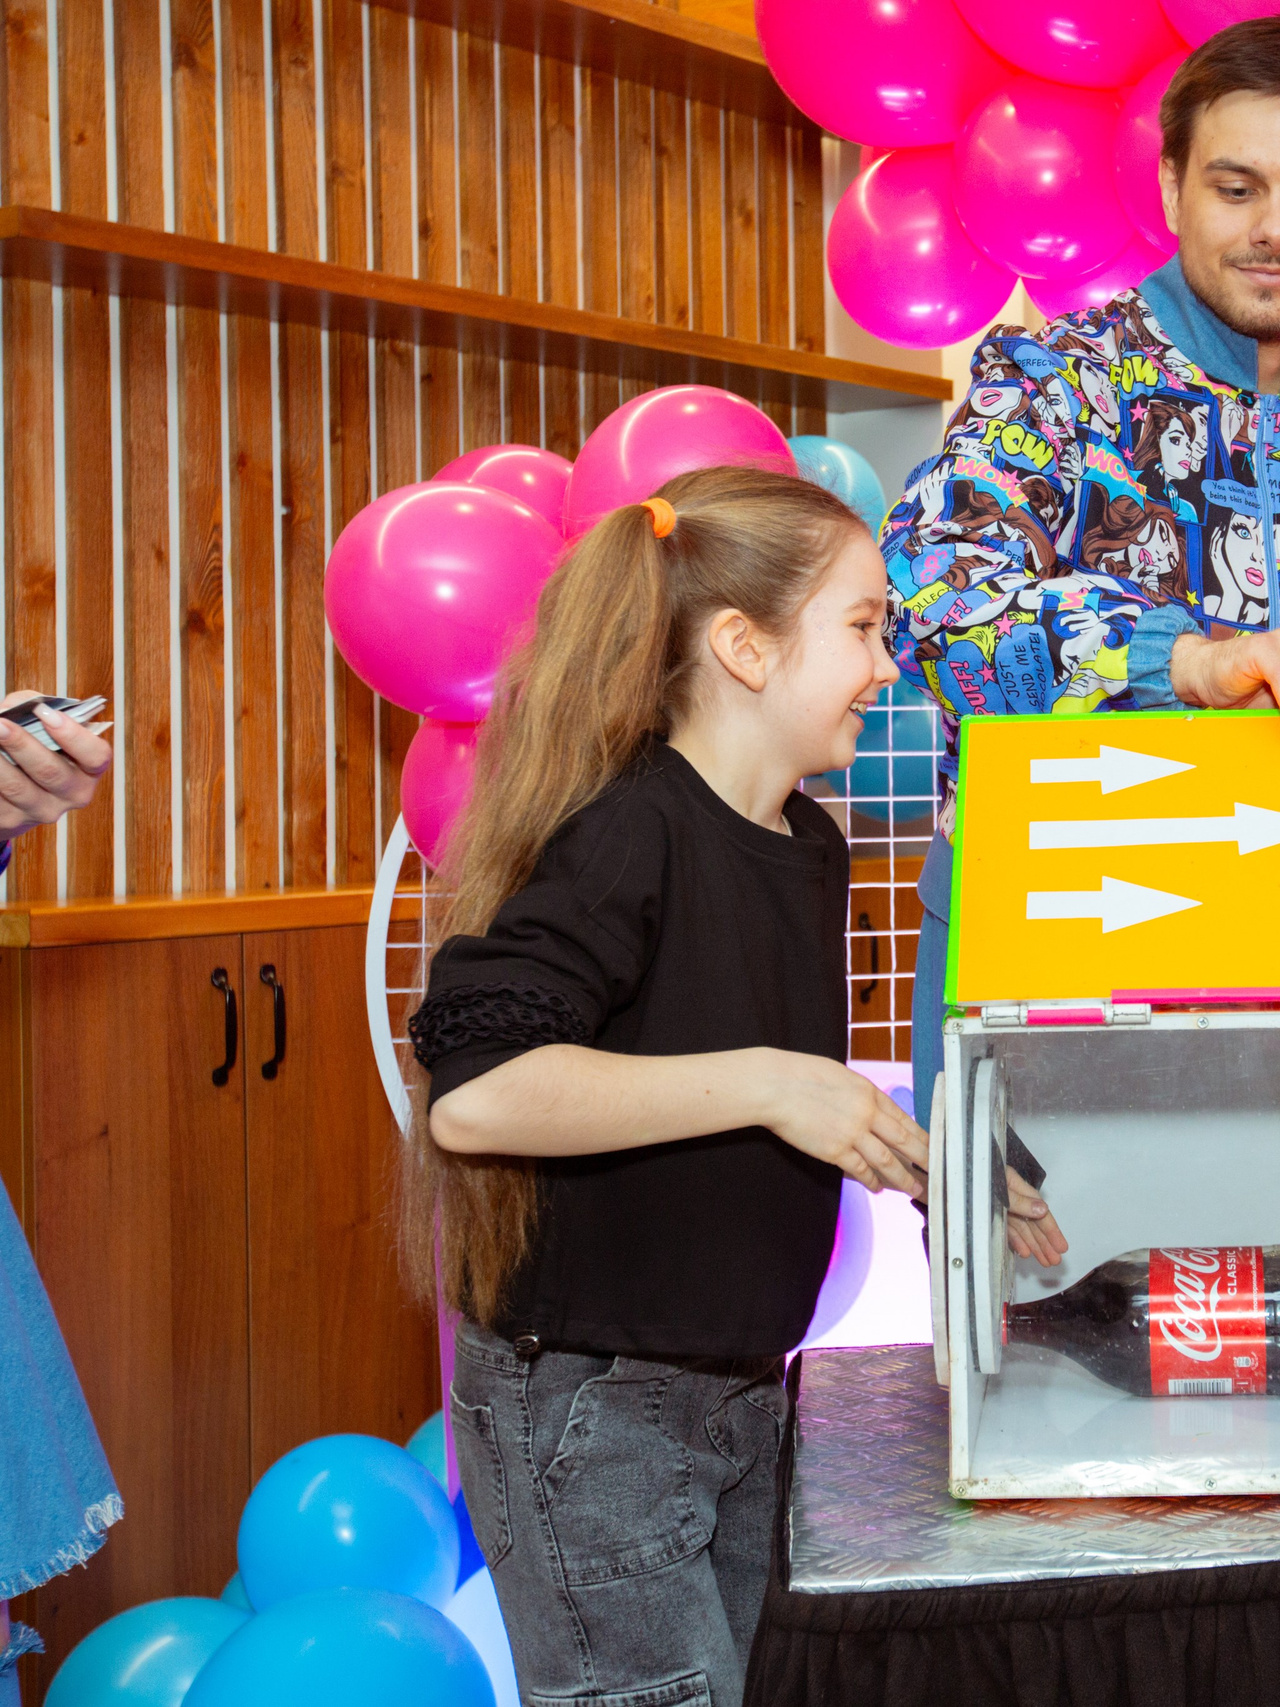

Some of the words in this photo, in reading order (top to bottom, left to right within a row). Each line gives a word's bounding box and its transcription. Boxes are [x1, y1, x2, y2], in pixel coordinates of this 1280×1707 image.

[1109, 355, 1159, 393] POW
[980, 418, 1055, 470] POW
[1014, 644, 1030, 666] ME
[998, 661, 1020, 698] JUST
[1226, 1250, 1238, 1296] CLASSIC
